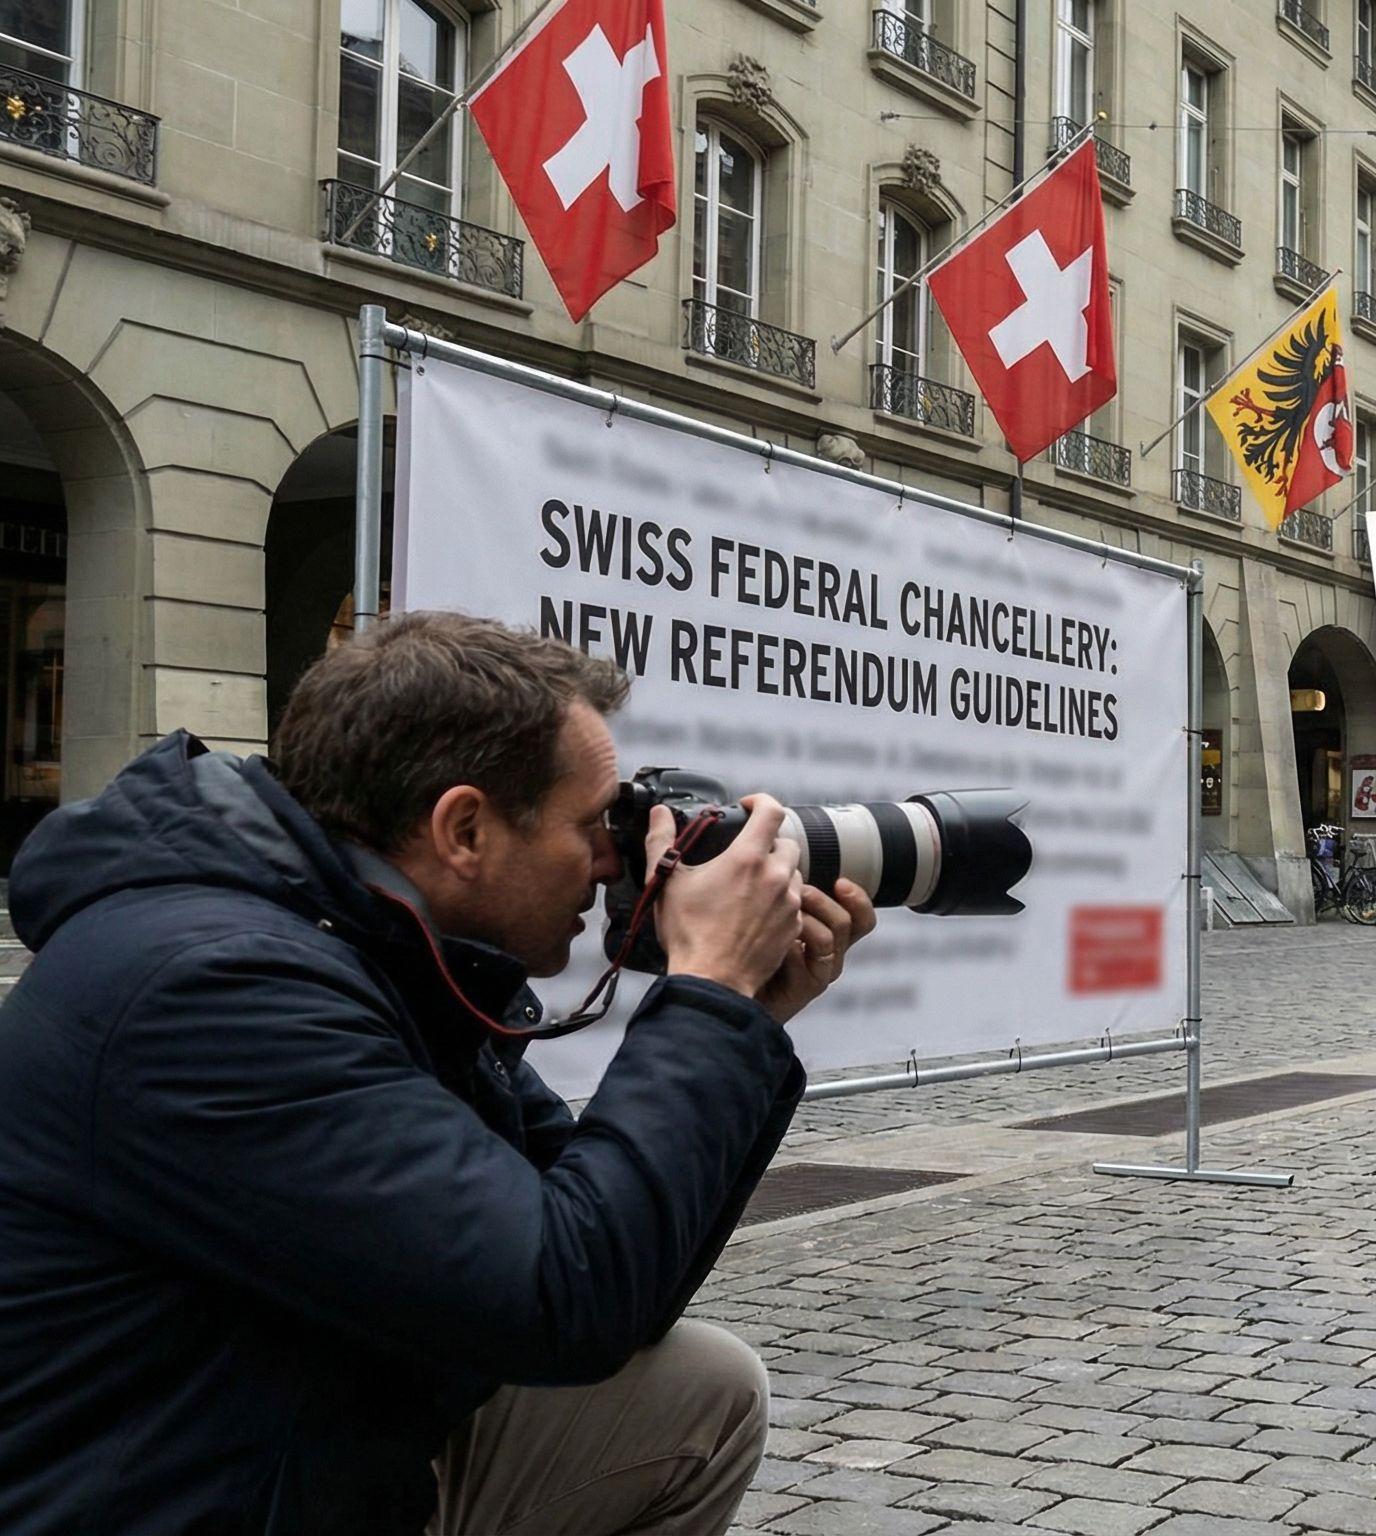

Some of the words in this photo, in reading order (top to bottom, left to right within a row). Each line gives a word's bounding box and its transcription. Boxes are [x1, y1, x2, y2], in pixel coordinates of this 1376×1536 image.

[539, 499, 693, 592] SWISS
[711, 535, 888, 631] FEDERAL
[900, 581, 1118, 675] CHANCELLERY:
[540, 595, 654, 677] NEW
[671, 618, 937, 717] REFERENDUM
[950, 667, 1118, 742] GUIDELINES
